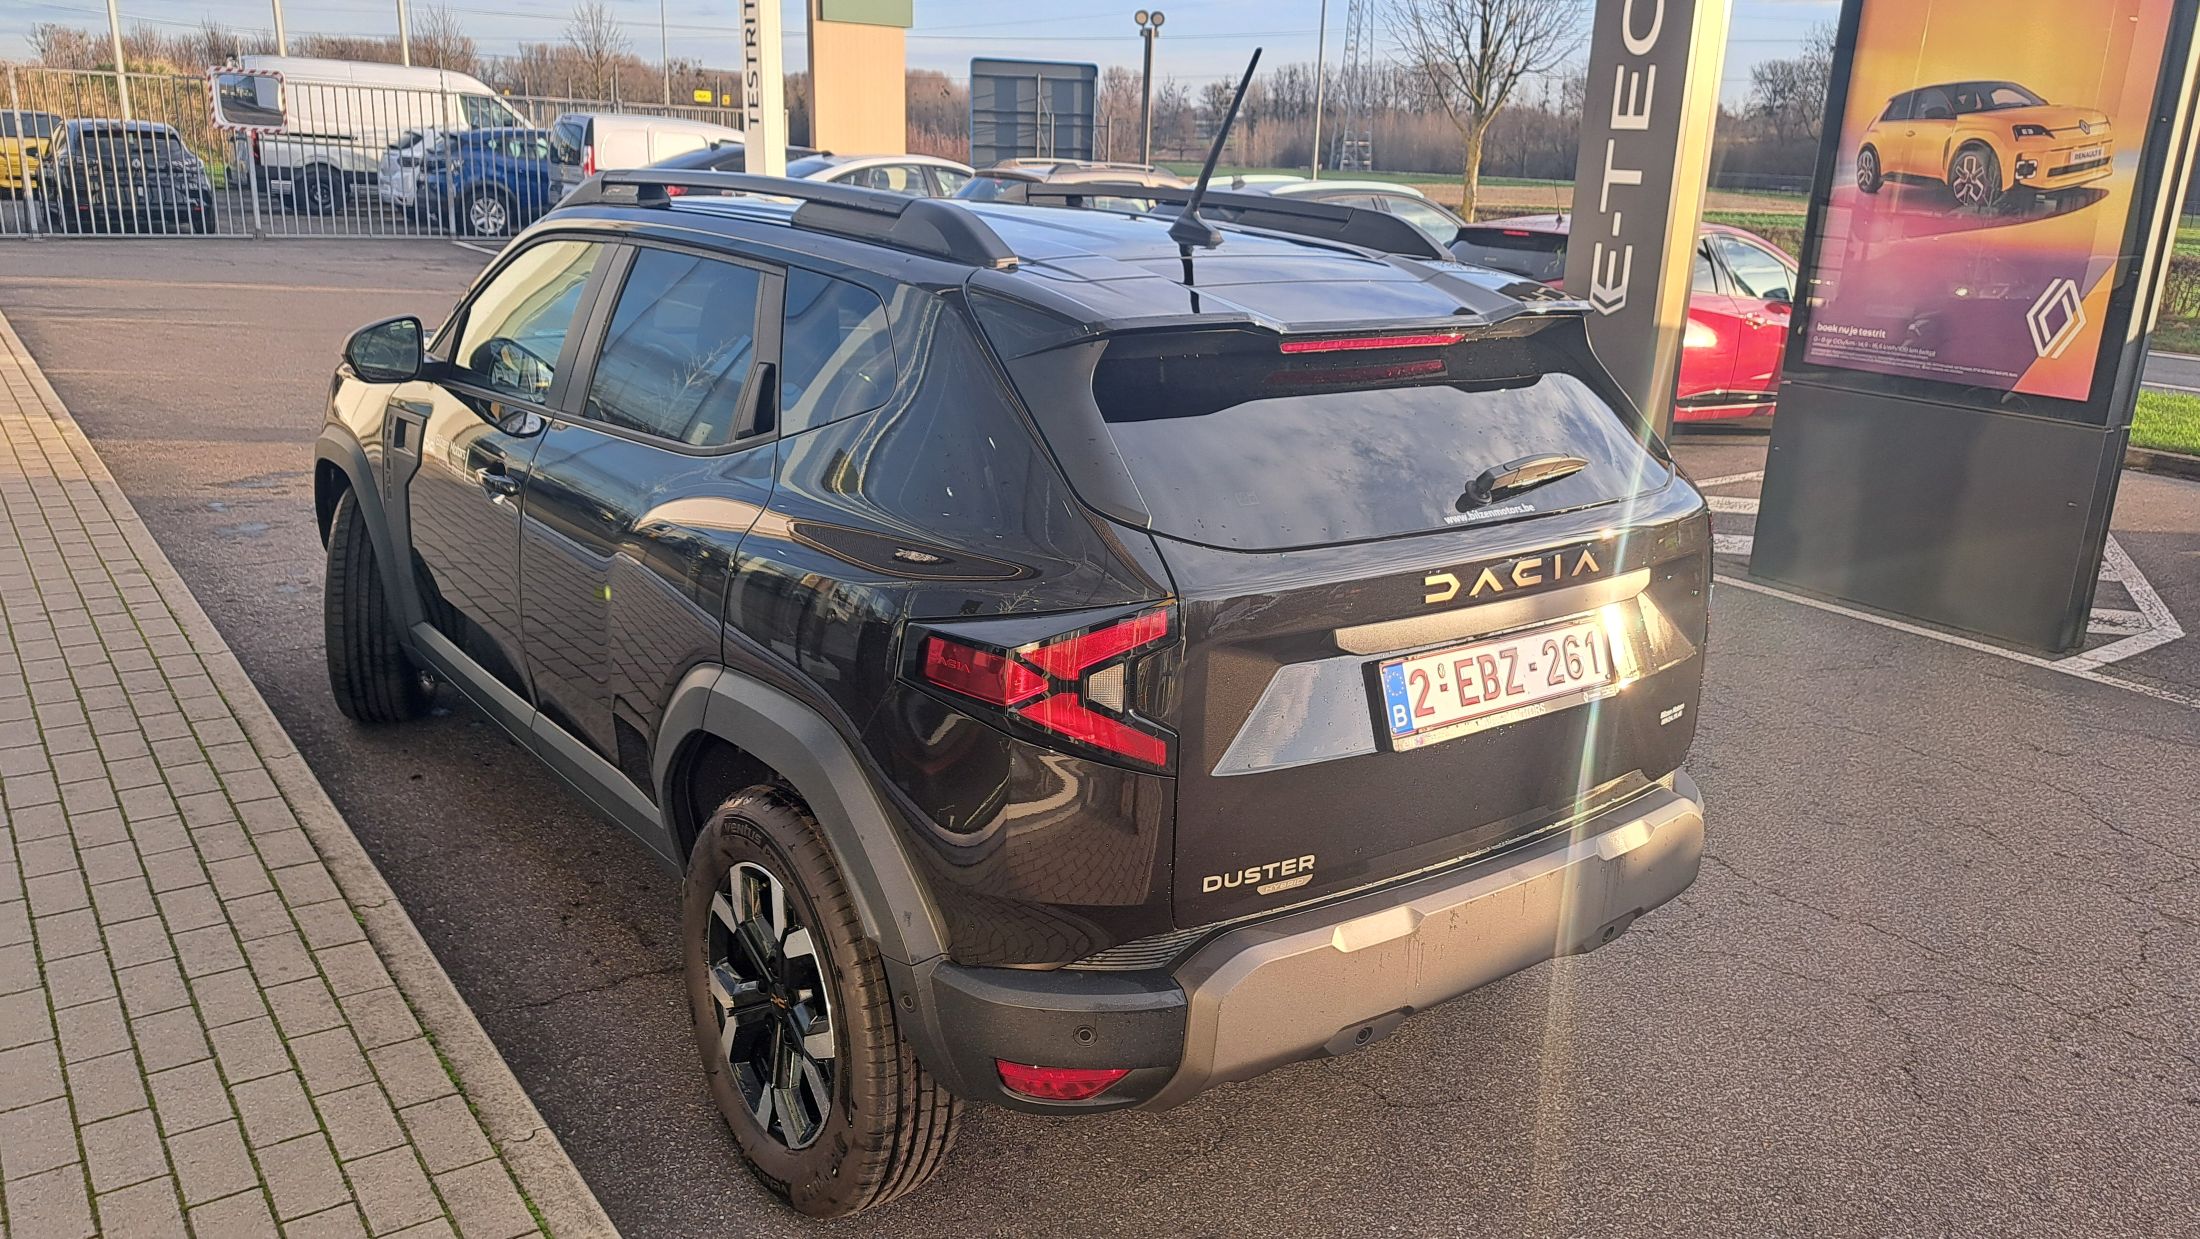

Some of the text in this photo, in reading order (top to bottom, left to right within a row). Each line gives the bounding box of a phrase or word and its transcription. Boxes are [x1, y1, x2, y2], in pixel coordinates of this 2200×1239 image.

[744, 0, 760, 130] TESTRIT
[1589, 0, 1664, 316] E-TEC
[1816, 322, 1838, 333] boek
[1858, 328, 1886, 339] testrit
[1443, 502, 1536, 525] www.bilzenmotors.be
[1424, 548, 1600, 604] DACIA
[1392, 704, 1409, 728] B
[1202, 854, 1316, 893] DUSTER
[1265, 878, 1304, 893] HYBRID
